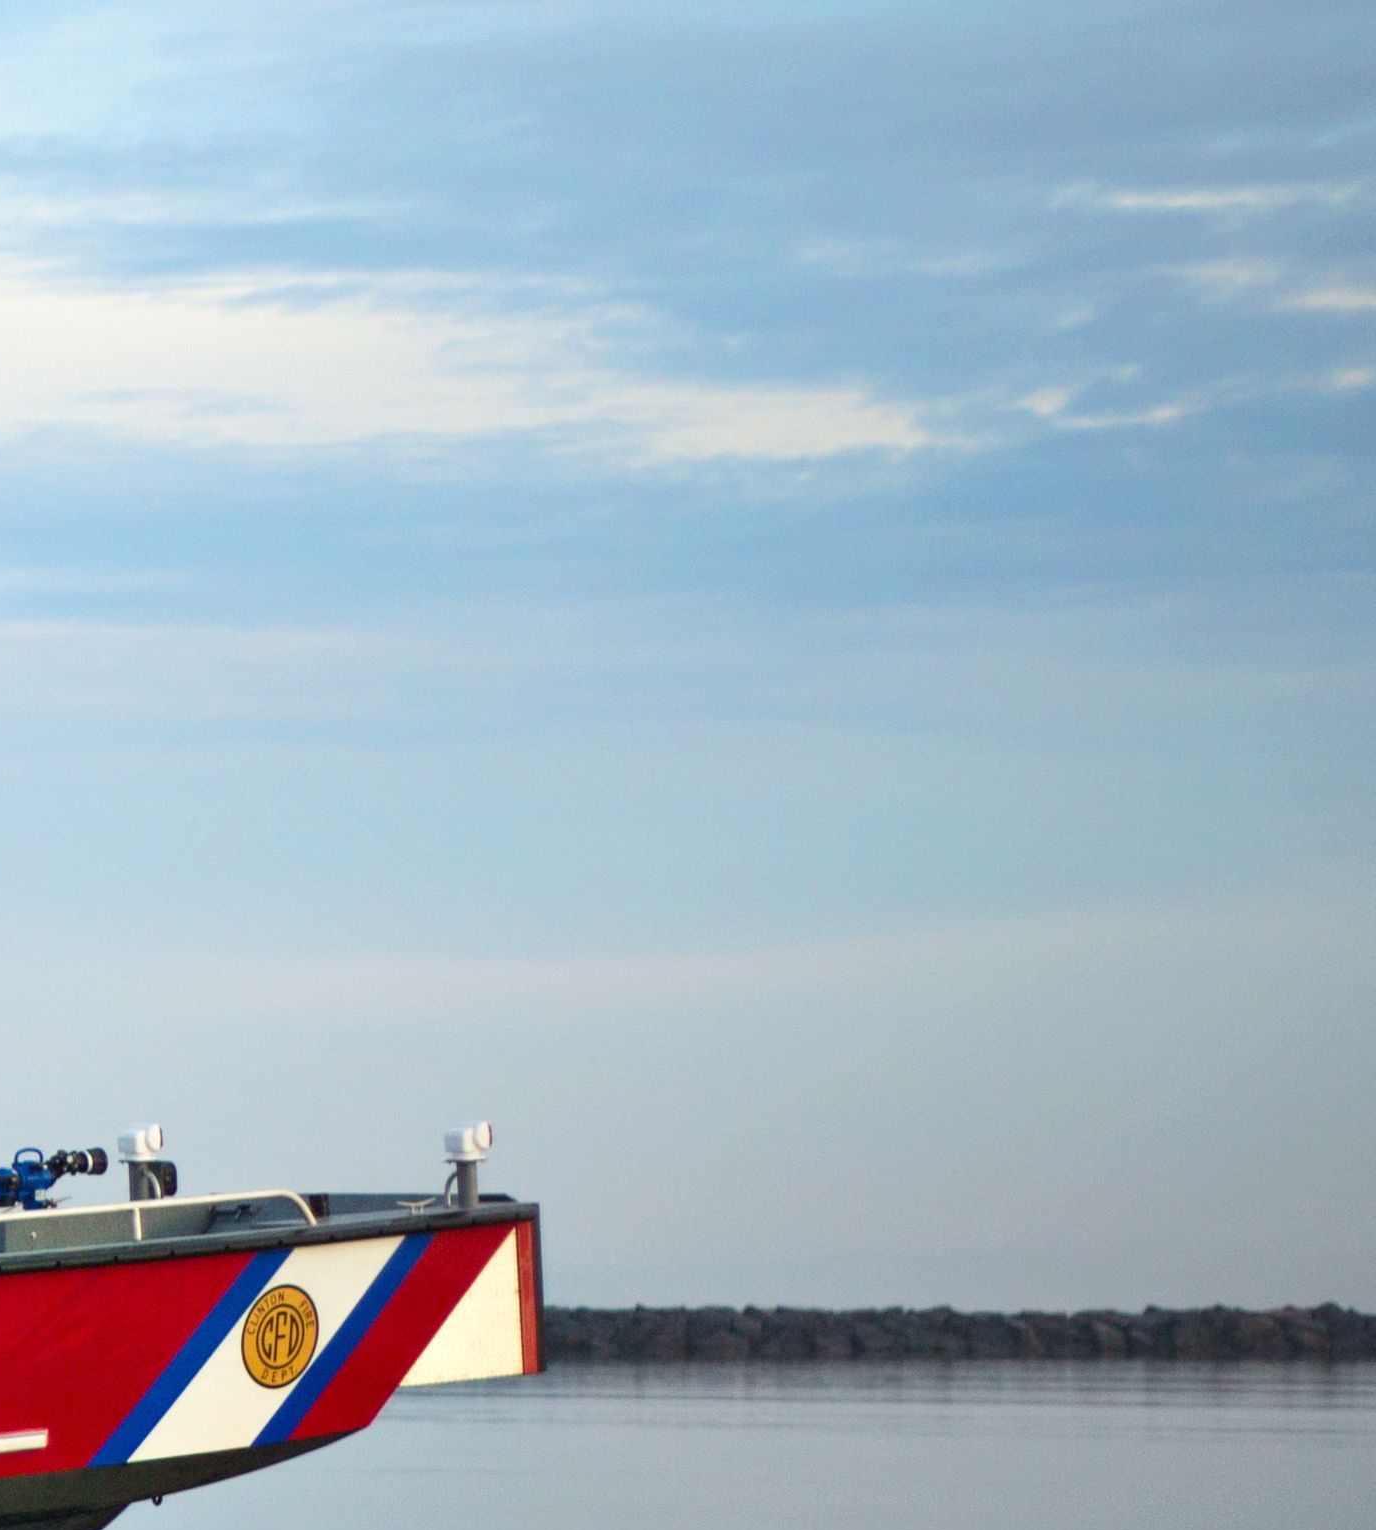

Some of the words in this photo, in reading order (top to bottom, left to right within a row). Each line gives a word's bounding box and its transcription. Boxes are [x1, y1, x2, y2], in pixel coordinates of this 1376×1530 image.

[248, 1291, 285, 1335] CLINTON
[299, 1301, 315, 1329] FIRE
[262, 1311, 299, 1362] CFD
